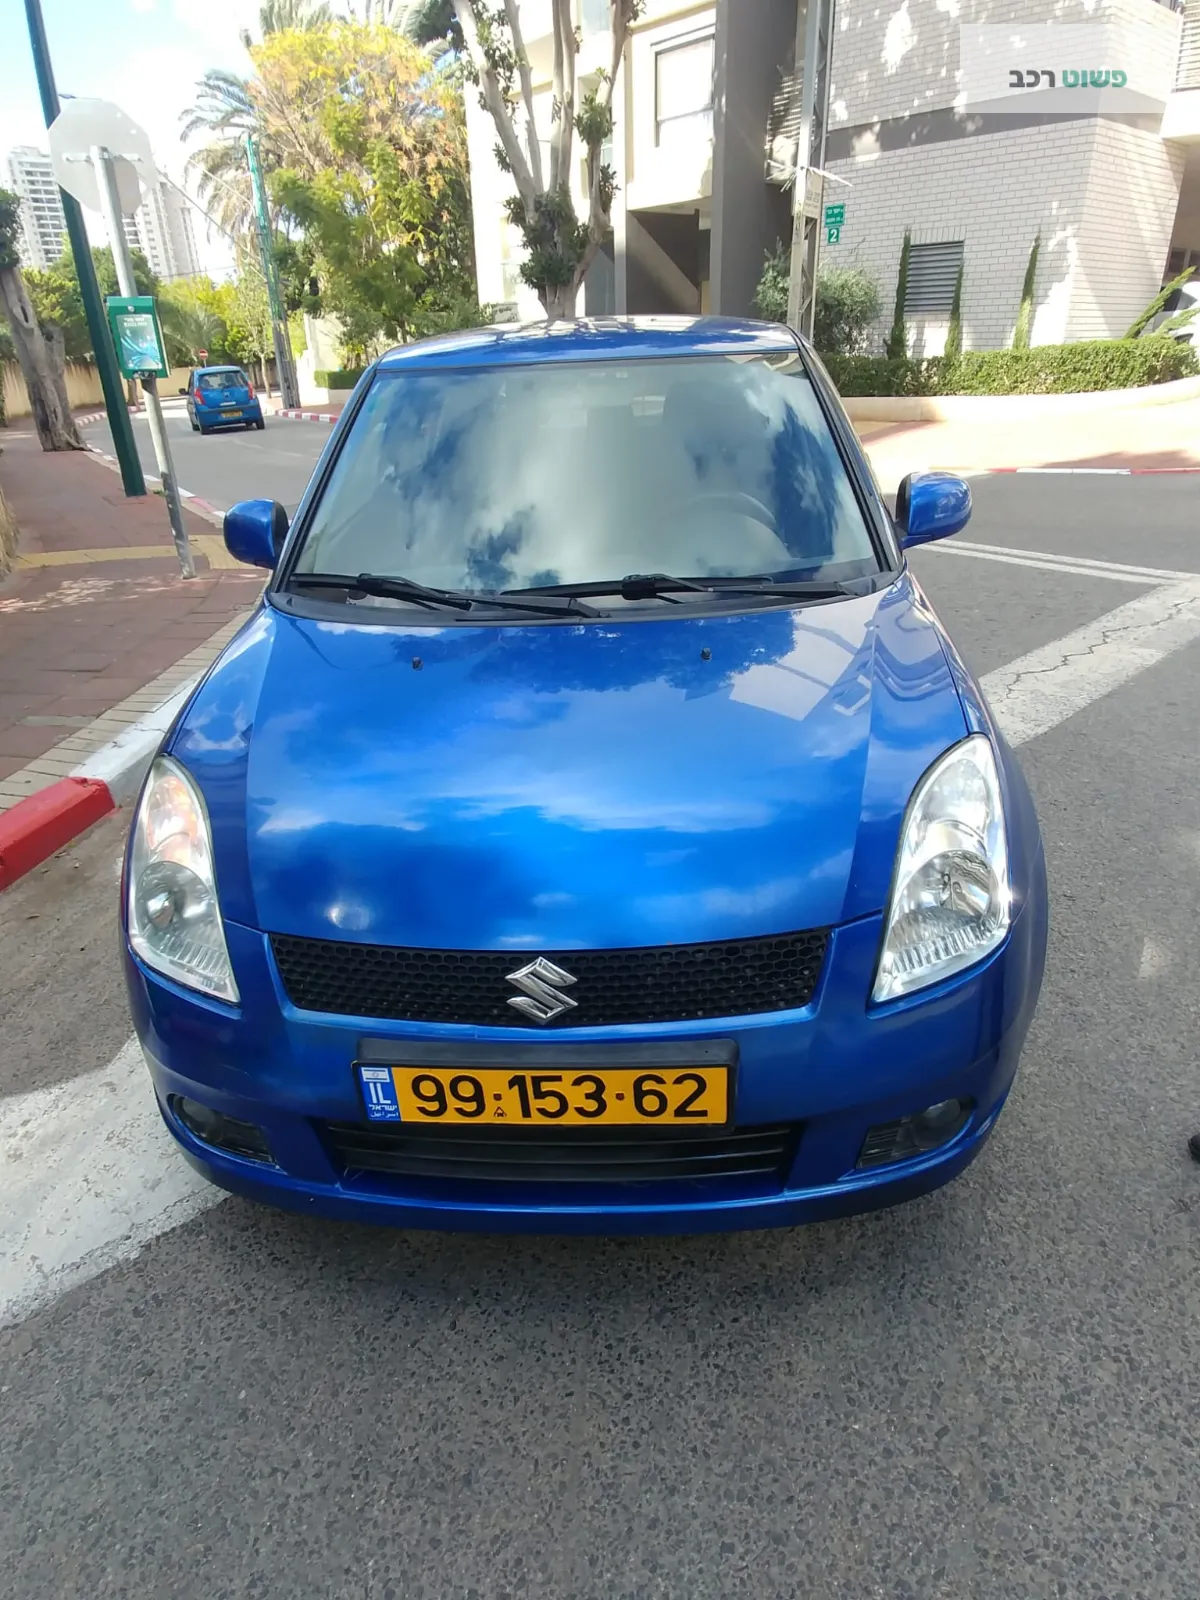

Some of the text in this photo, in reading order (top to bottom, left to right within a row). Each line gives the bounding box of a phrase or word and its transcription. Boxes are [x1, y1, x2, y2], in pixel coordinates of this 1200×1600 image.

[829, 228, 838, 243] 2
[368, 1082, 392, 1105] IL
[368, 1104, 398, 1112] ישראל
